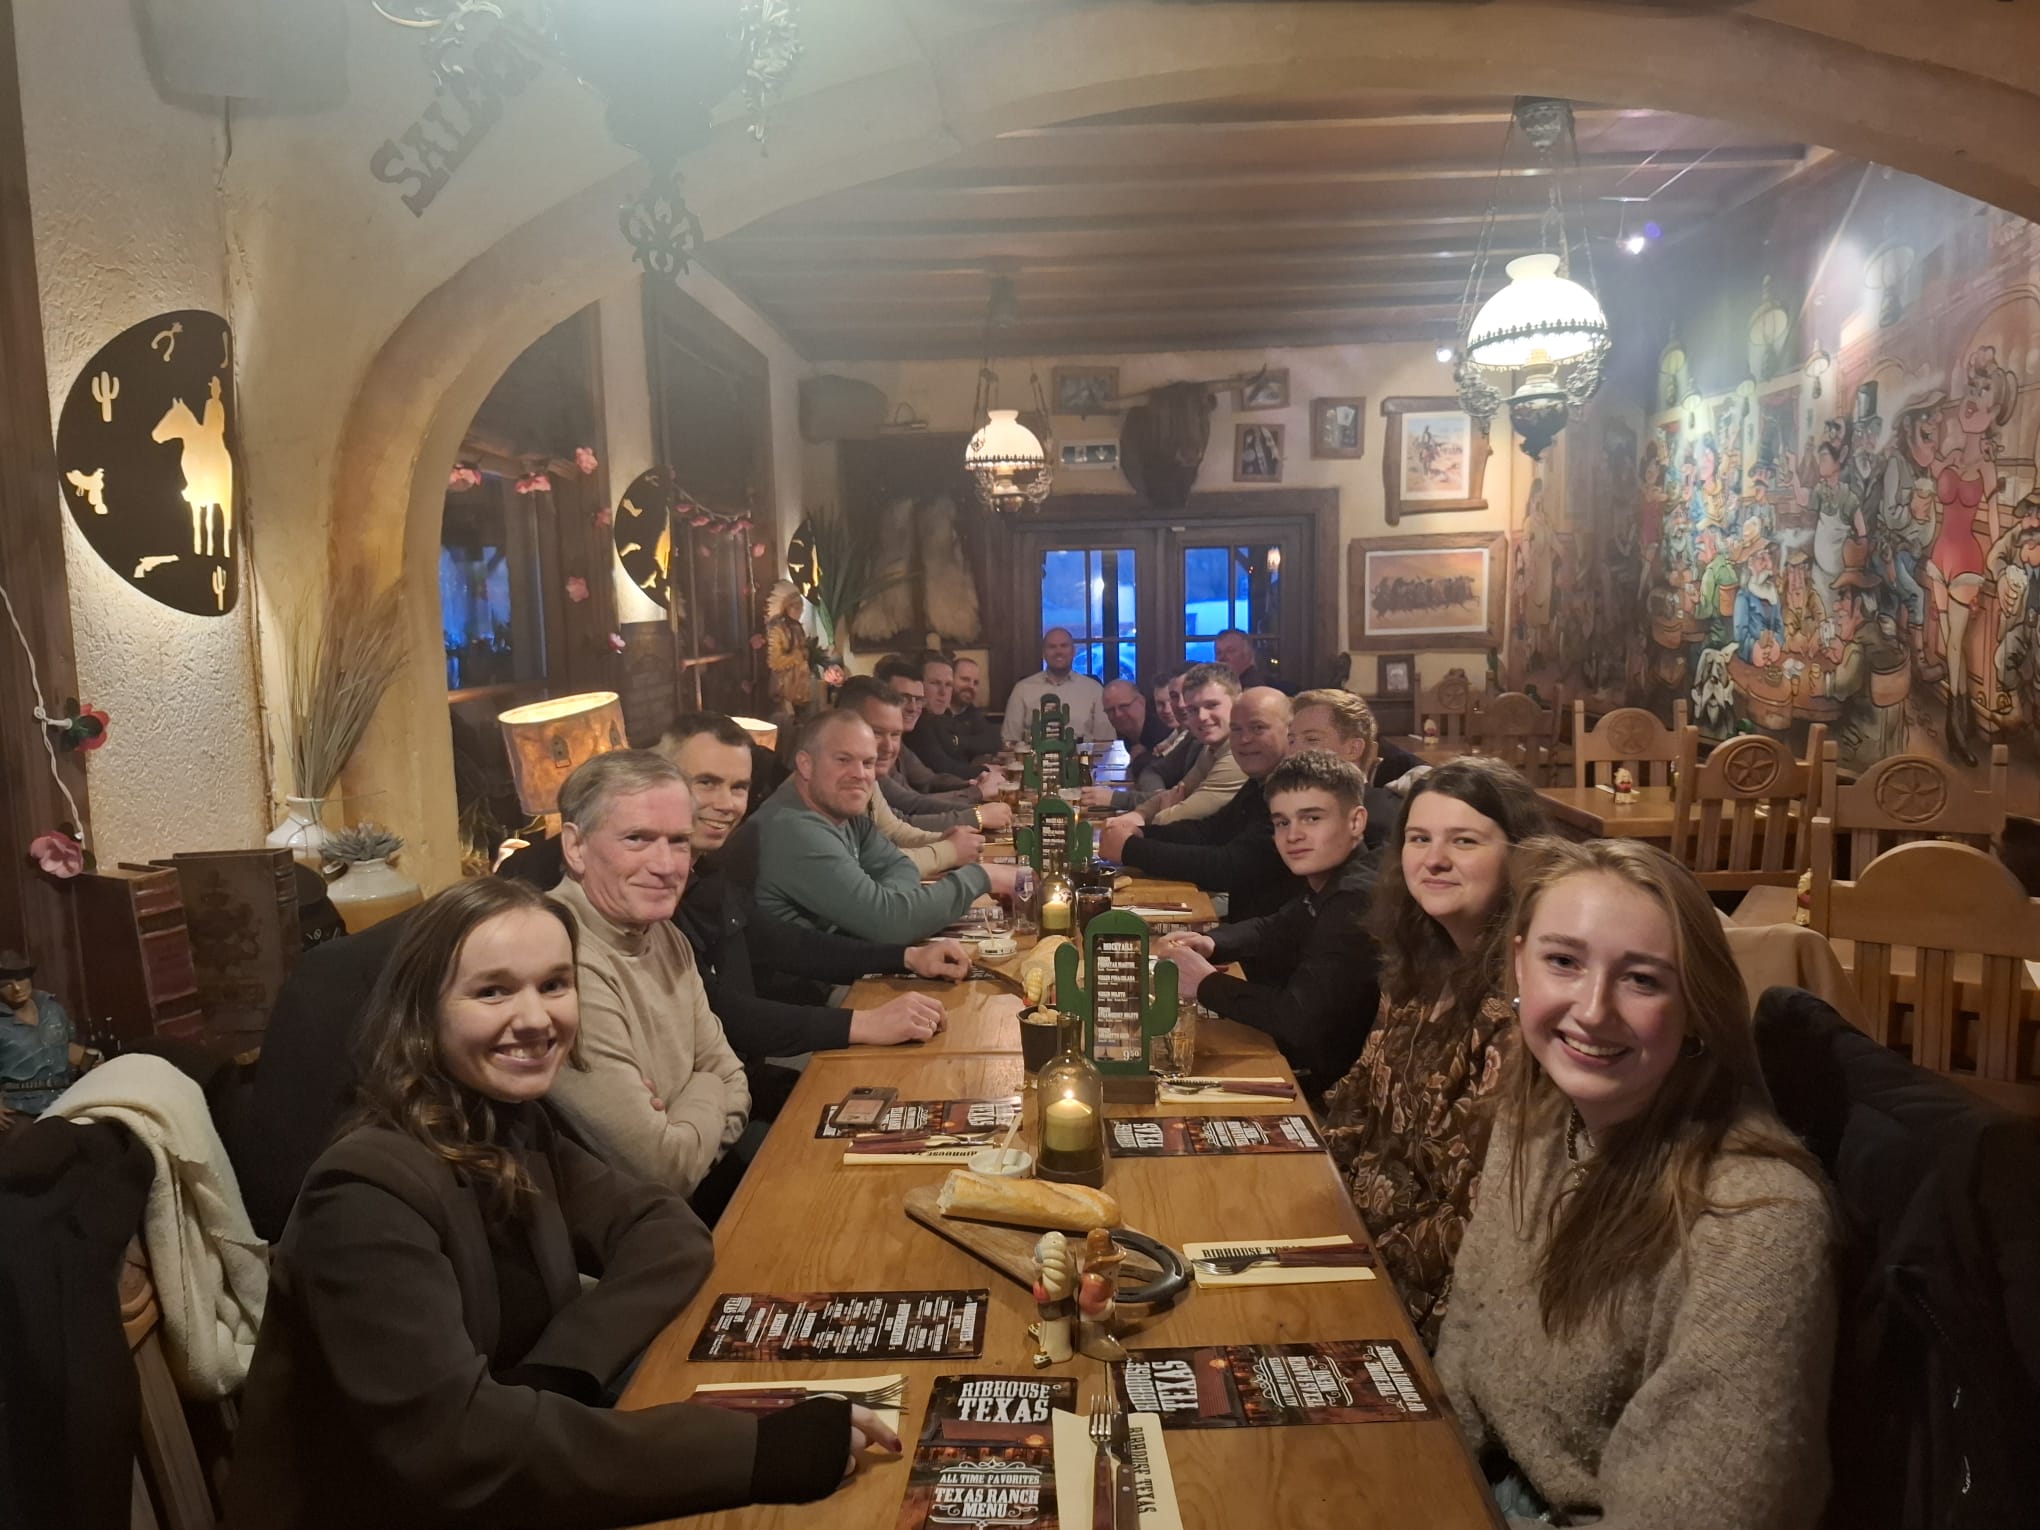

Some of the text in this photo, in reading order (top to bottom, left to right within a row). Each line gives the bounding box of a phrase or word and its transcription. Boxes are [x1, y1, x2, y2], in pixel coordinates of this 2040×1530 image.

[1132, 1122, 1164, 1149] TEXAS
[961, 1381, 1050, 1399] RIBHOUSE
[1124, 1361, 1161, 1412] RIBHOUSE
[1151, 1360, 1199, 1412] TEXAS
[1287, 1356, 1326, 1407] TEXAS RANCH
[1311, 1369, 1340, 1392] MENU
[1375, 1345, 1428, 1412] OF COWBOY CUISINE
[1377, 1380, 1399, 1397] THE
[957, 1397, 1050, 1424] TEXAS
[1284, 1396, 1300, 1407] ALL
[939, 1473, 1041, 1485] ALL TIME FAVORITES
[1128, 1426, 1158, 1514] RIBHOUSE TEXAS
[934, 1487, 1040, 1505] TEXAS RANCH
[961, 1502, 1008, 1519] MENU
